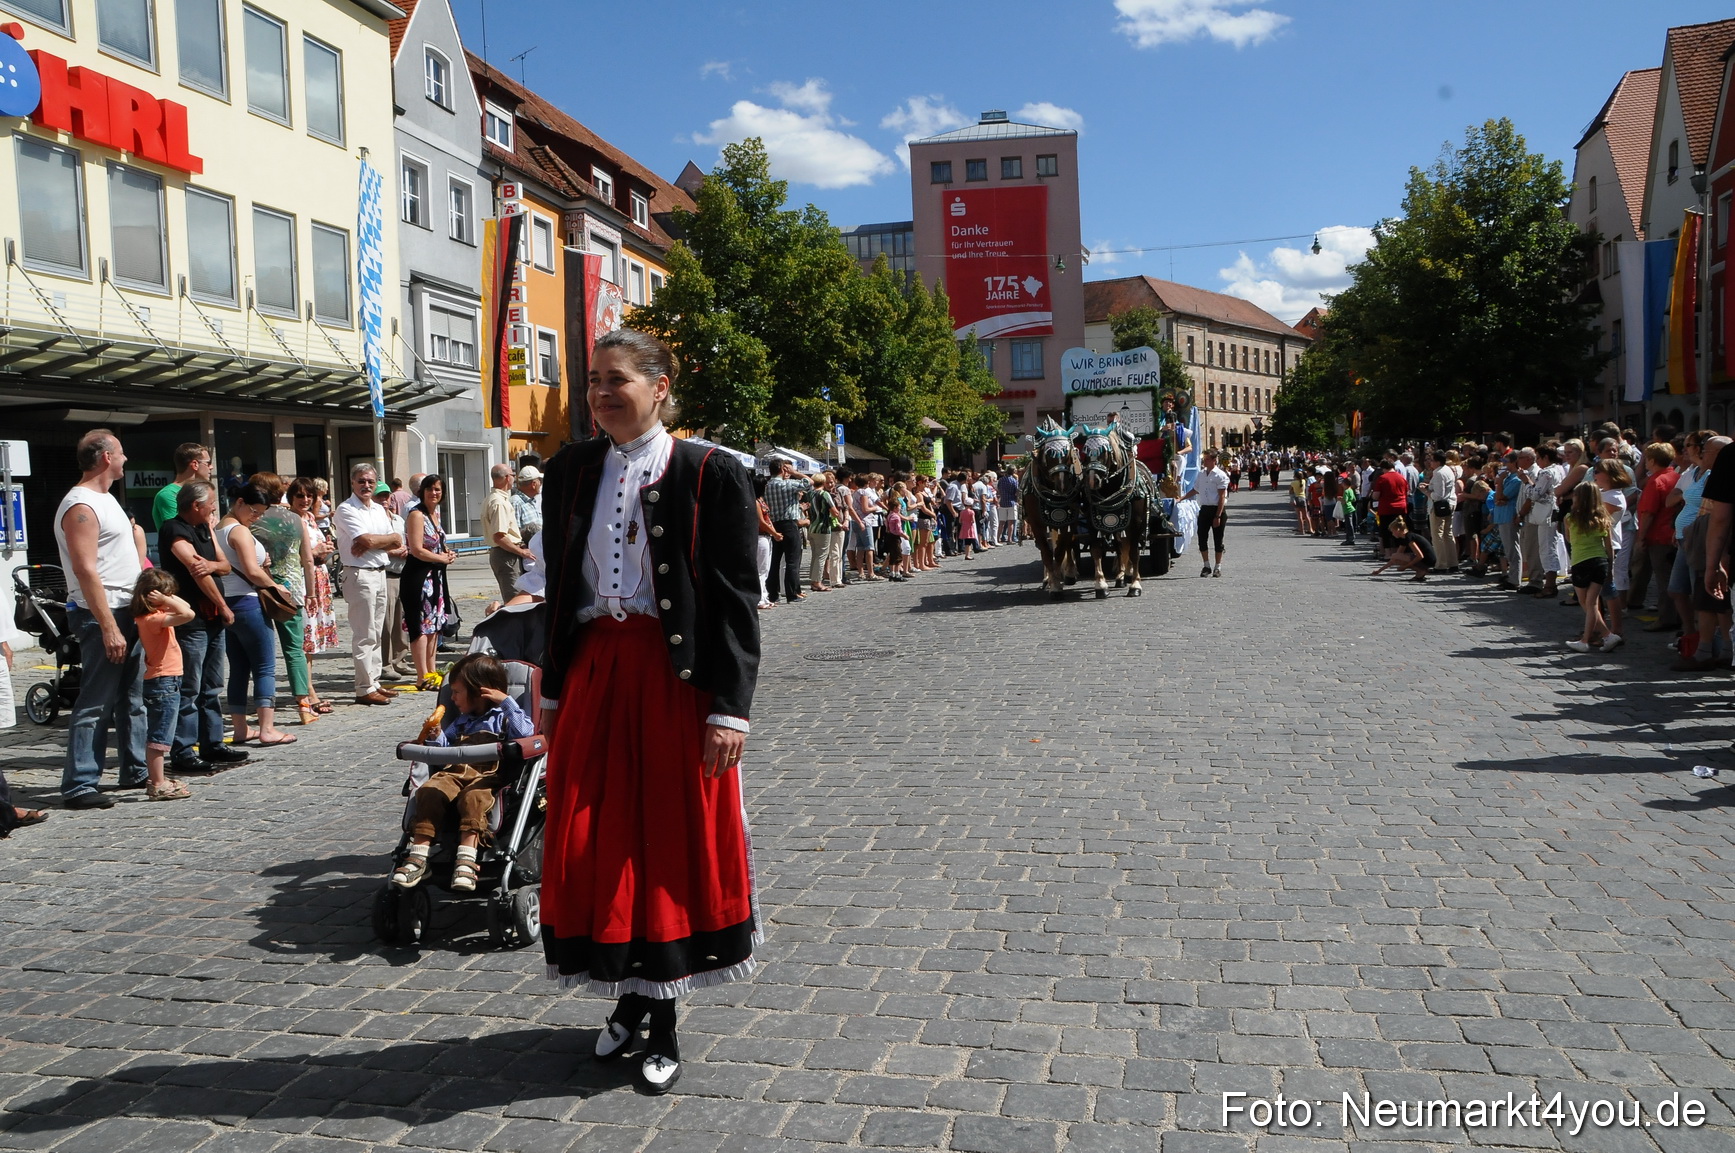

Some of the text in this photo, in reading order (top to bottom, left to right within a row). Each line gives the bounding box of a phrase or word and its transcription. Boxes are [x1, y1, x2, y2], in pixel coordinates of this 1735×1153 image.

[951, 224, 989, 236] Danke
[951, 240, 1014, 249] für Ihr Vertrauen
[952, 250, 1009, 259] und Ihre Treue.
[983, 275, 1020, 291] 175
[985, 290, 1020, 300] JAHRE
[507, 350, 525, 362] café
[1070, 352, 1147, 370] WIR BRINGEN
[1071, 371, 1159, 391] OLYMPISCHE FEUER
[837, 427, 843, 438] P
[133, 472, 168, 487] Aktion
